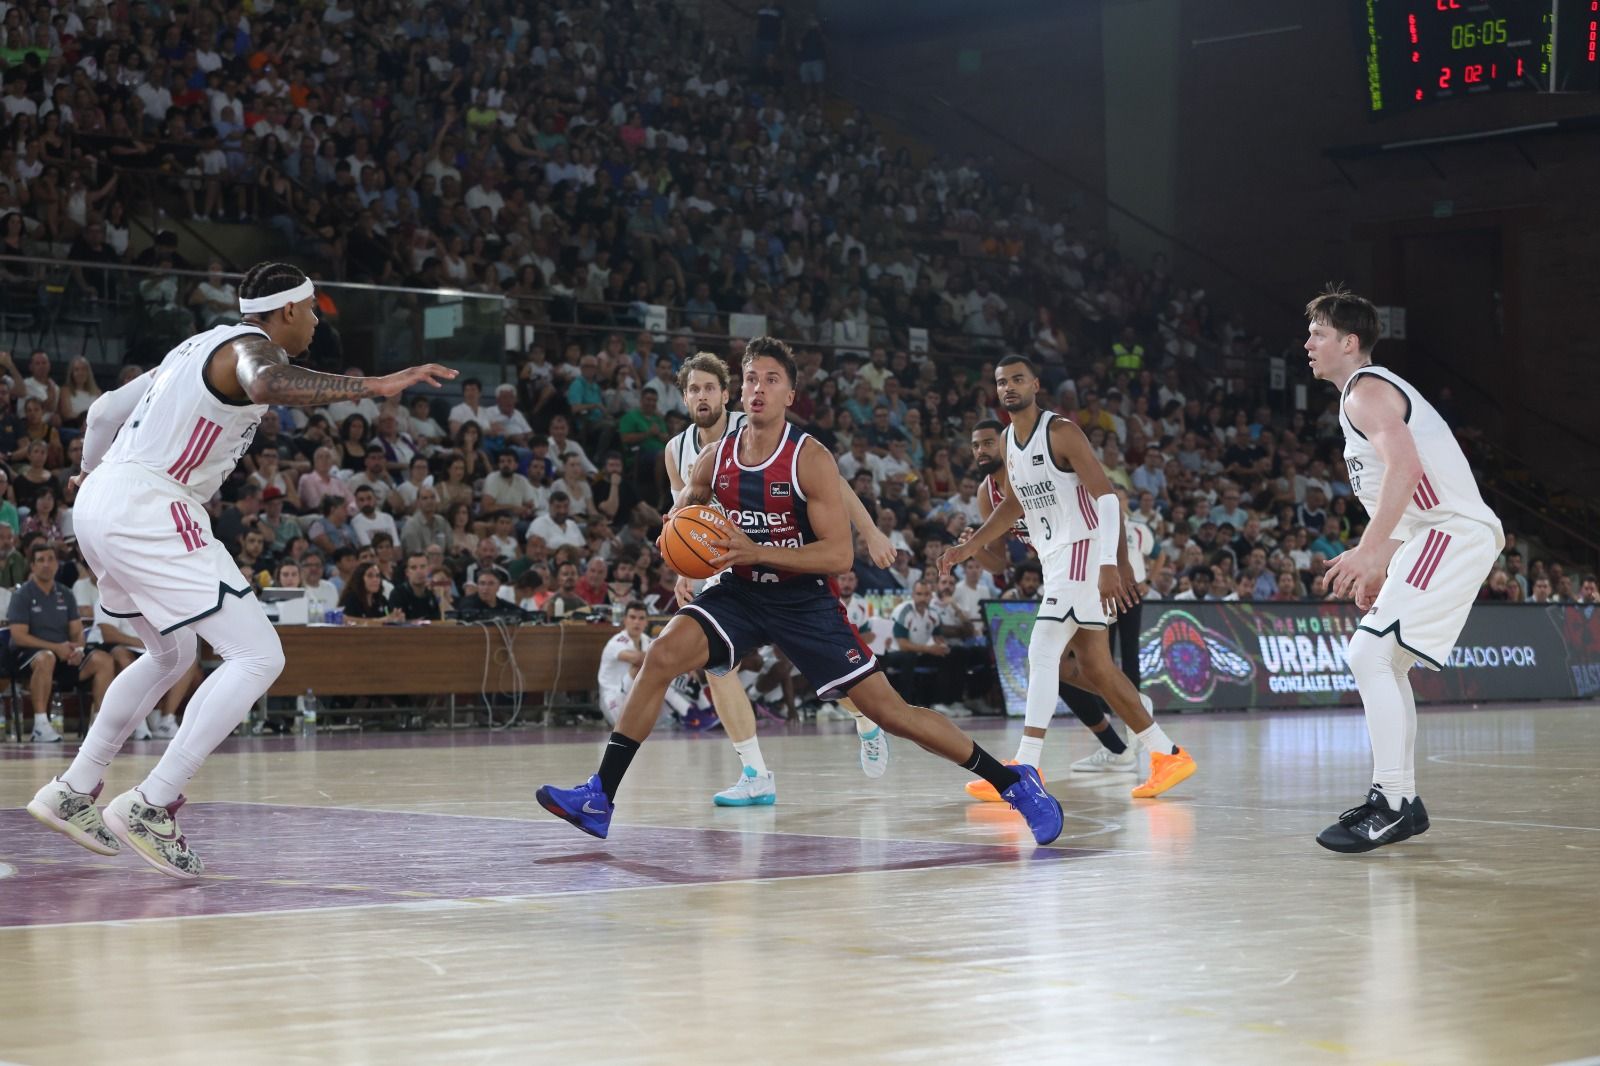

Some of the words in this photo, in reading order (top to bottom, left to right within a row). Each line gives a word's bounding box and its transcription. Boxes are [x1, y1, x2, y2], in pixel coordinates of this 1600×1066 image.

[1451, 19, 1506, 49] 06:05
[1440, 67, 1450, 88] 2
[727, 509, 790, 526] osner
[1040, 515, 1052, 541] 3
[1500, 645, 1537, 667] POR
[1331, 674, 1359, 691] ESC
